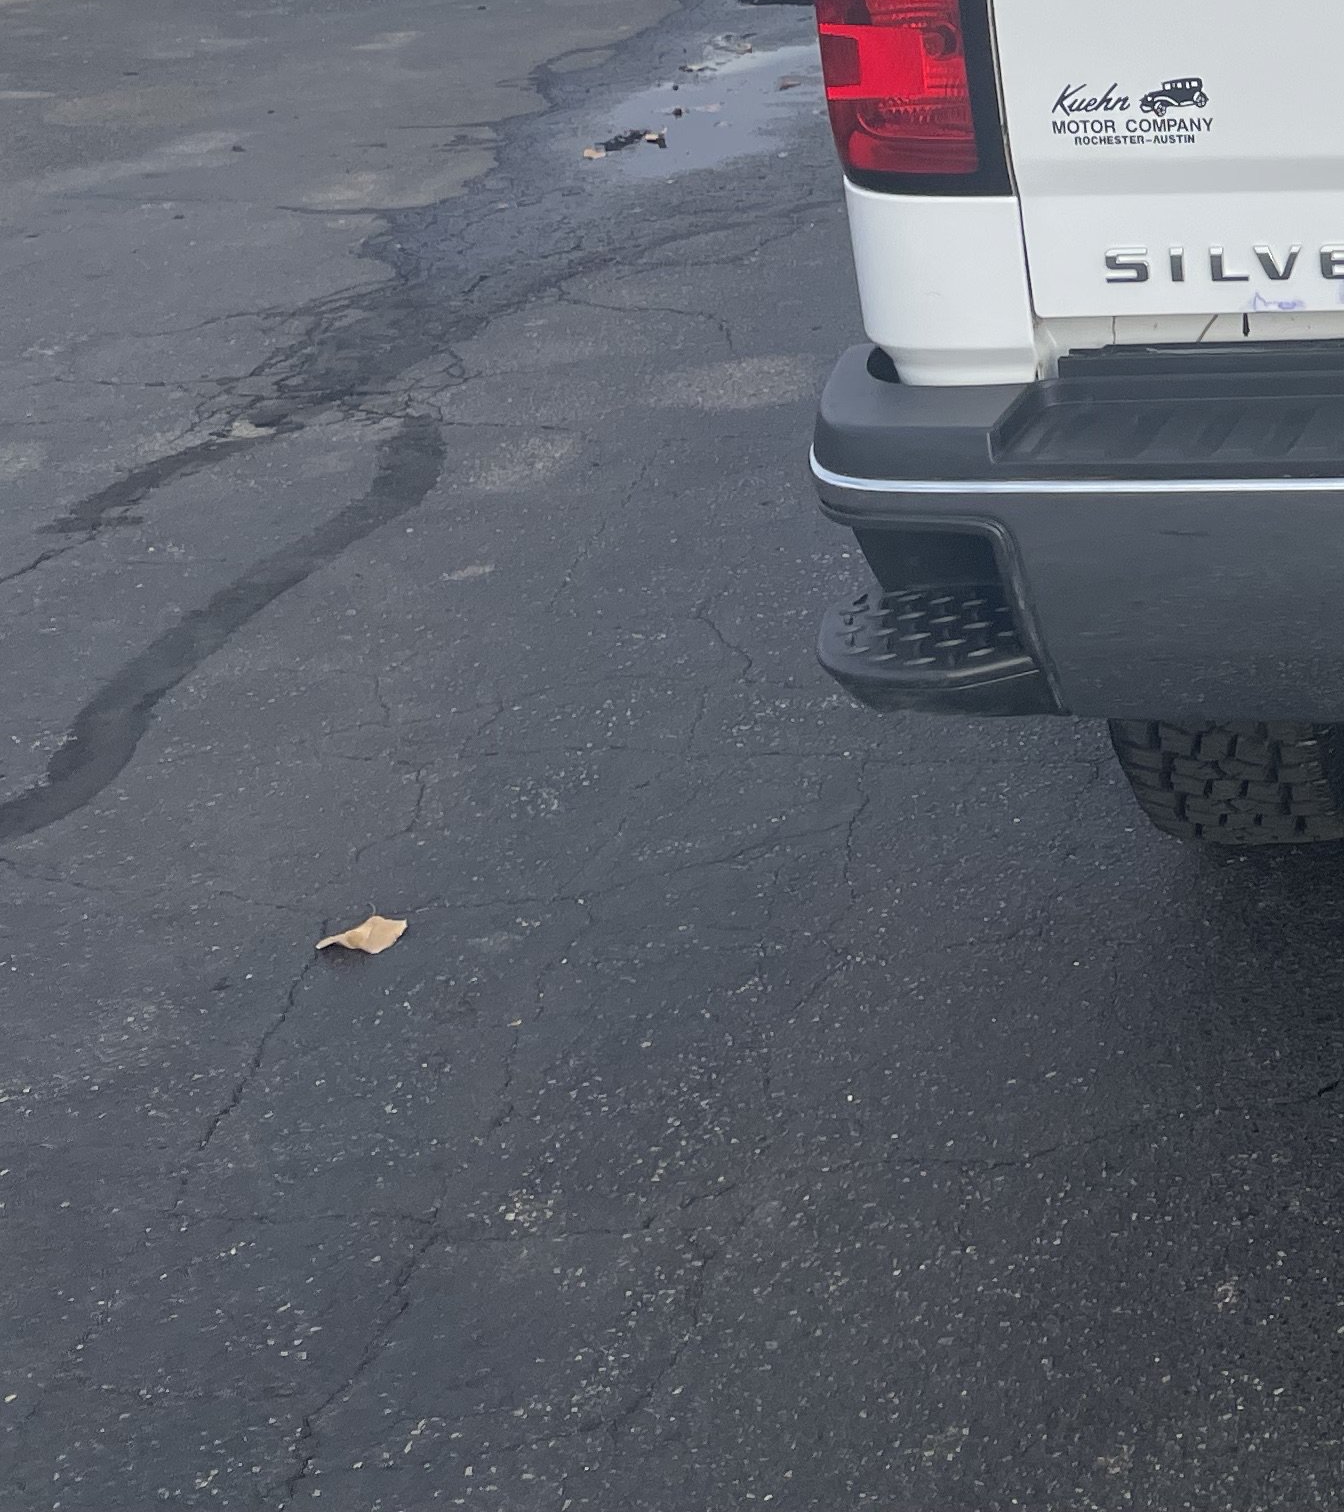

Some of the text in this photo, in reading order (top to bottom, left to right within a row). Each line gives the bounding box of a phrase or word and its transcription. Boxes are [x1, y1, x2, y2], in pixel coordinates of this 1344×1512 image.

[1052, 82, 1131, 117] Kuehn
[1052, 117, 1214, 135] MOTOR COMPANY
